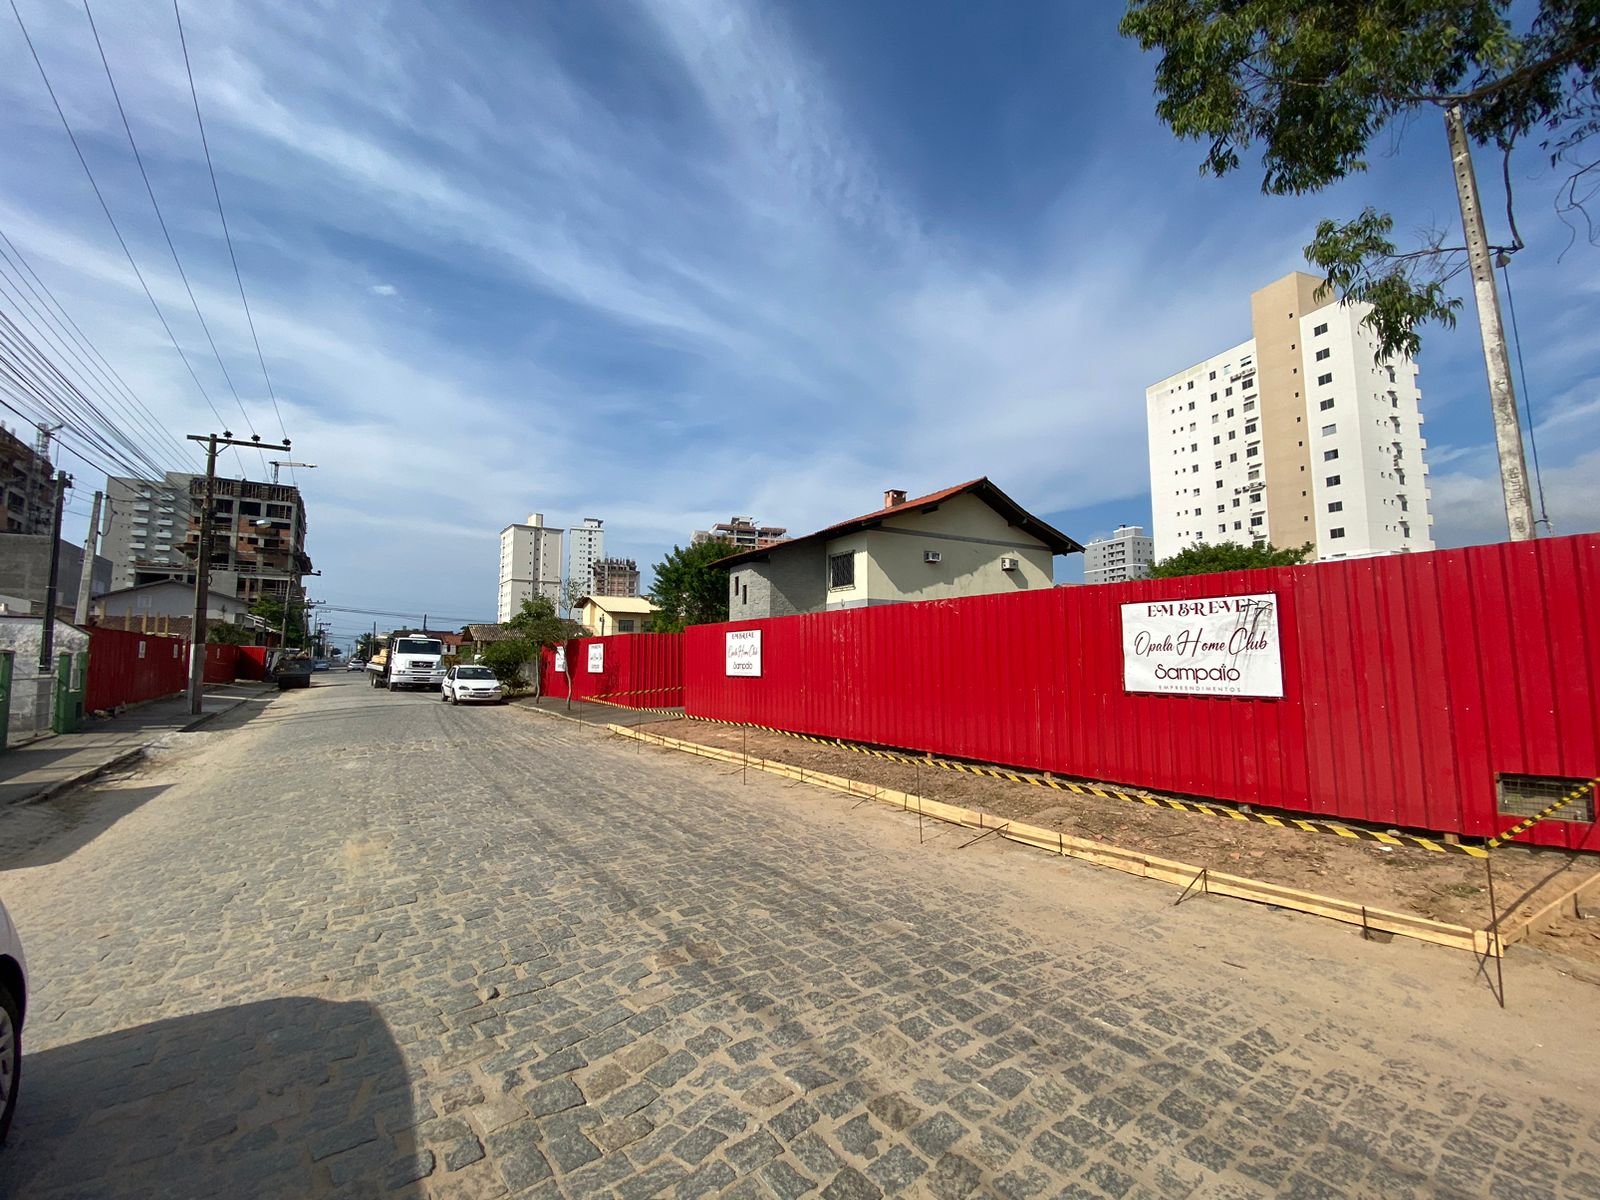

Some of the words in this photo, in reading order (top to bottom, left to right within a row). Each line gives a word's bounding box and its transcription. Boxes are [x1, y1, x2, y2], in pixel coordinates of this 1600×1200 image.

[1147, 604, 1174, 617] EM
[1178, 599, 1247, 616] BREVE
[1134, 630, 1174, 657] Opala
[1176, 627, 1226, 657] Home
[1228, 627, 1268, 655] Club
[1158, 685, 1241, 693] EMPREENDIMENTOS
